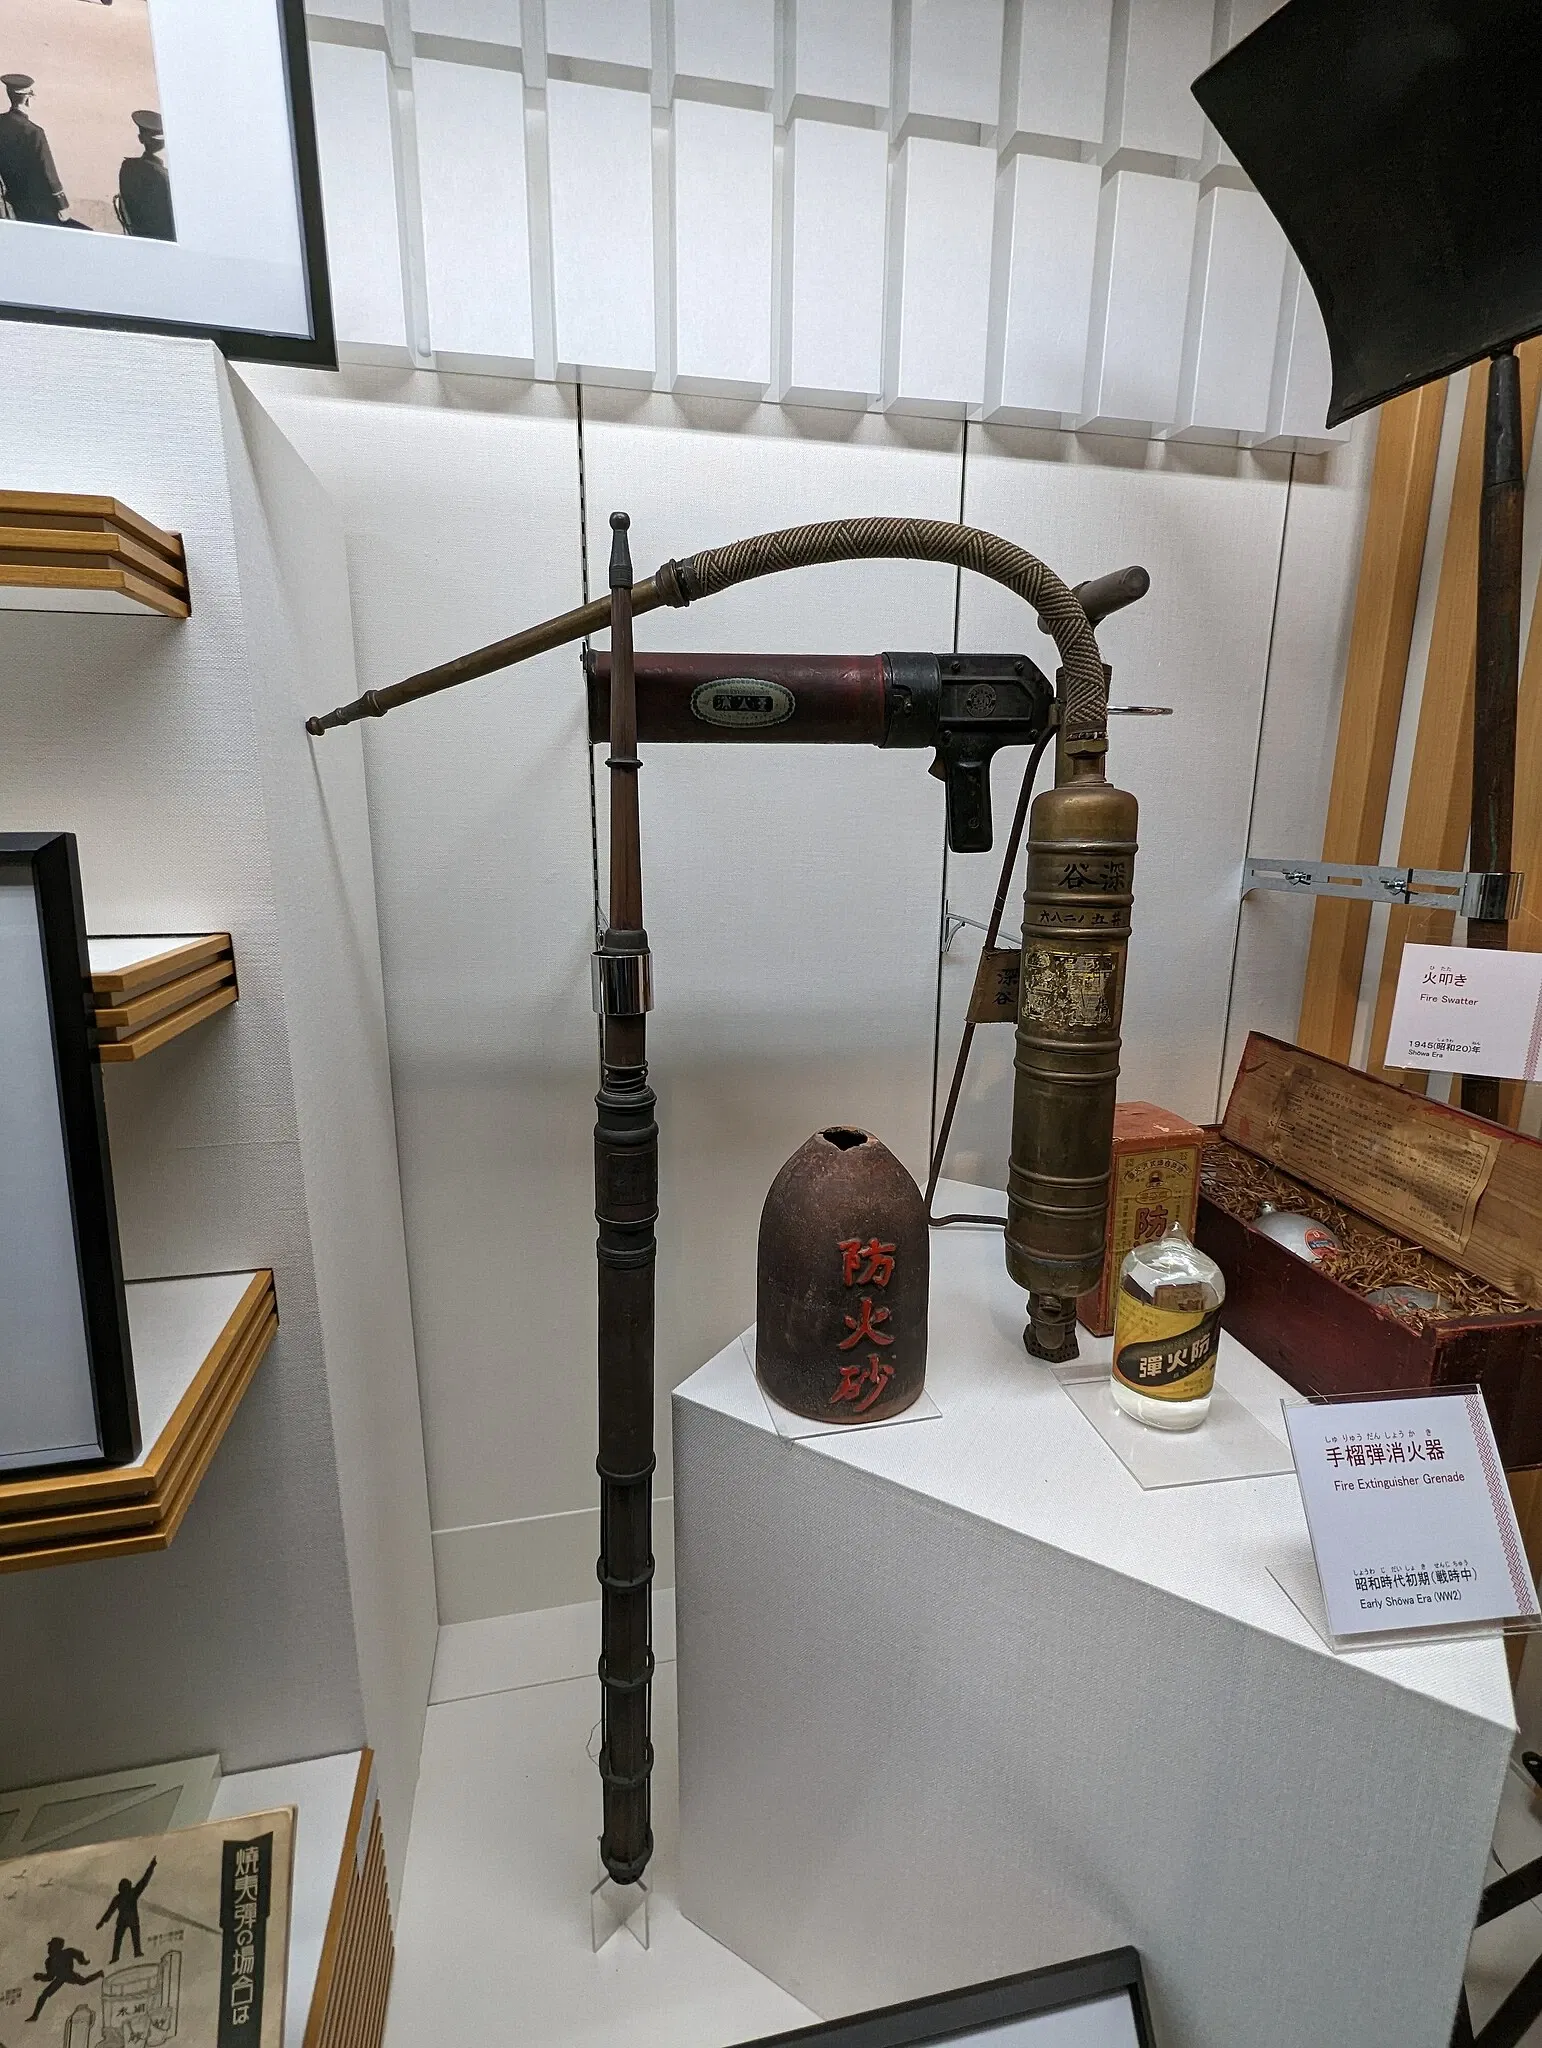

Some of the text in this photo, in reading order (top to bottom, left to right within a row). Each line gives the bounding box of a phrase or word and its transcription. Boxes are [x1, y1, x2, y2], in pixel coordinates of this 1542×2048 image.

[1422, 972, 1468, 987] 火叩き
[1420, 993, 1479, 1006] Fire Swatter
[1409, 1040, 1481, 1053] 1945(昭和20)年
[831, 1237, 897, 1413] 防火砂
[1325, 1438, 1445, 1468] 手榴弾消火器
[1334, 1471, 1466, 1491] Fire Extinguisher Grenade
[1355, 1567, 1477, 1592] 昭和時代初期(戦時中)
[1360, 1599, 1383, 1609] Early
[1416, 1593, 1432, 1604] Era
[1434, 1589, 1462, 1602] (WW2)
